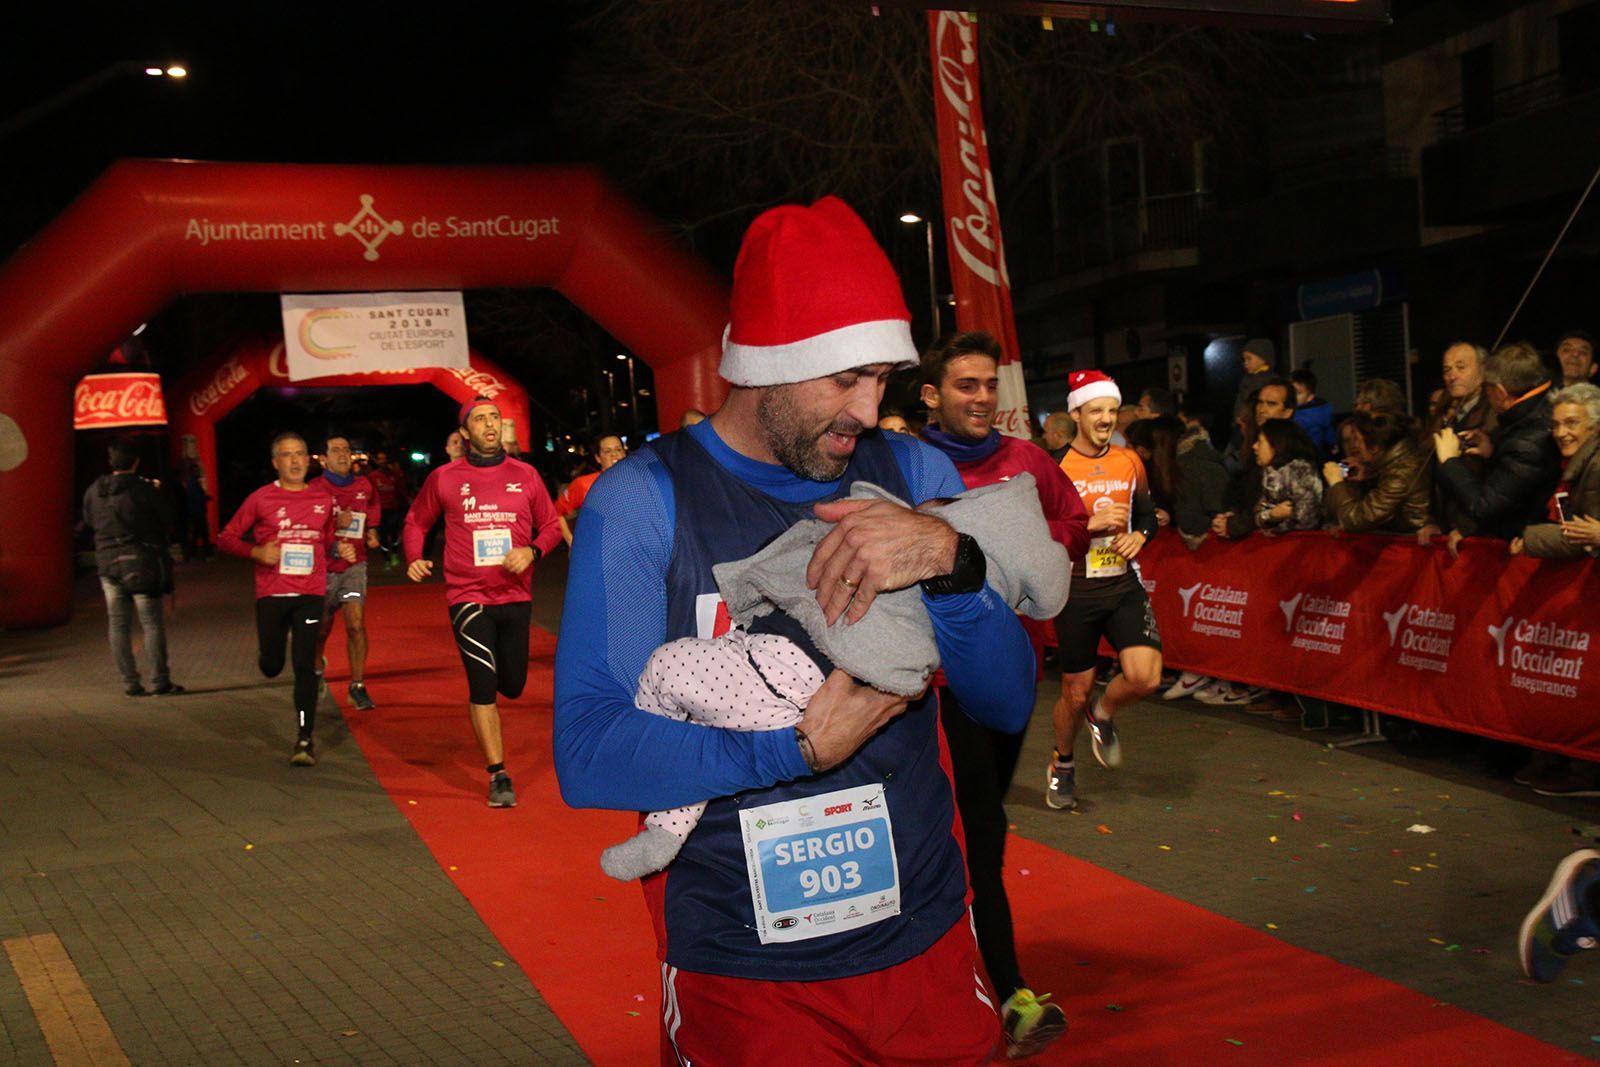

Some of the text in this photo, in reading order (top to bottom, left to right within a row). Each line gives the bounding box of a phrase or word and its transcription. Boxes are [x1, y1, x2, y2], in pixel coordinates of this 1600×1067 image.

[184, 215, 560, 246] Ajuntament de SantCugat
[368, 308, 450, 319] SANT CUGAT
[389, 318, 432, 329] 2018
[368, 328, 455, 340] CIUTAT EUROPEA
[381, 341, 396, 351] DE
[74, 381, 163, 420] Coca-Cola
[462, 496, 476, 511] 19
[1199, 583, 1249, 605] Catalana
[1301, 592, 1352, 618] Catalana
[1193, 602, 1244, 626] Occident
[1296, 614, 1347, 640] Occident
[1406, 604, 1456, 631] Catalana
[1401, 628, 1452, 656] Occident
[1514, 618, 1591, 651] Catalana
[1510, 645, 1584, 680] Occident
[1510, 673, 1577, 698] Assegurances
[824, 802, 852, 816] SPORT
[774, 827, 875, 866] SERGIO
[799, 861, 862, 898] 903
